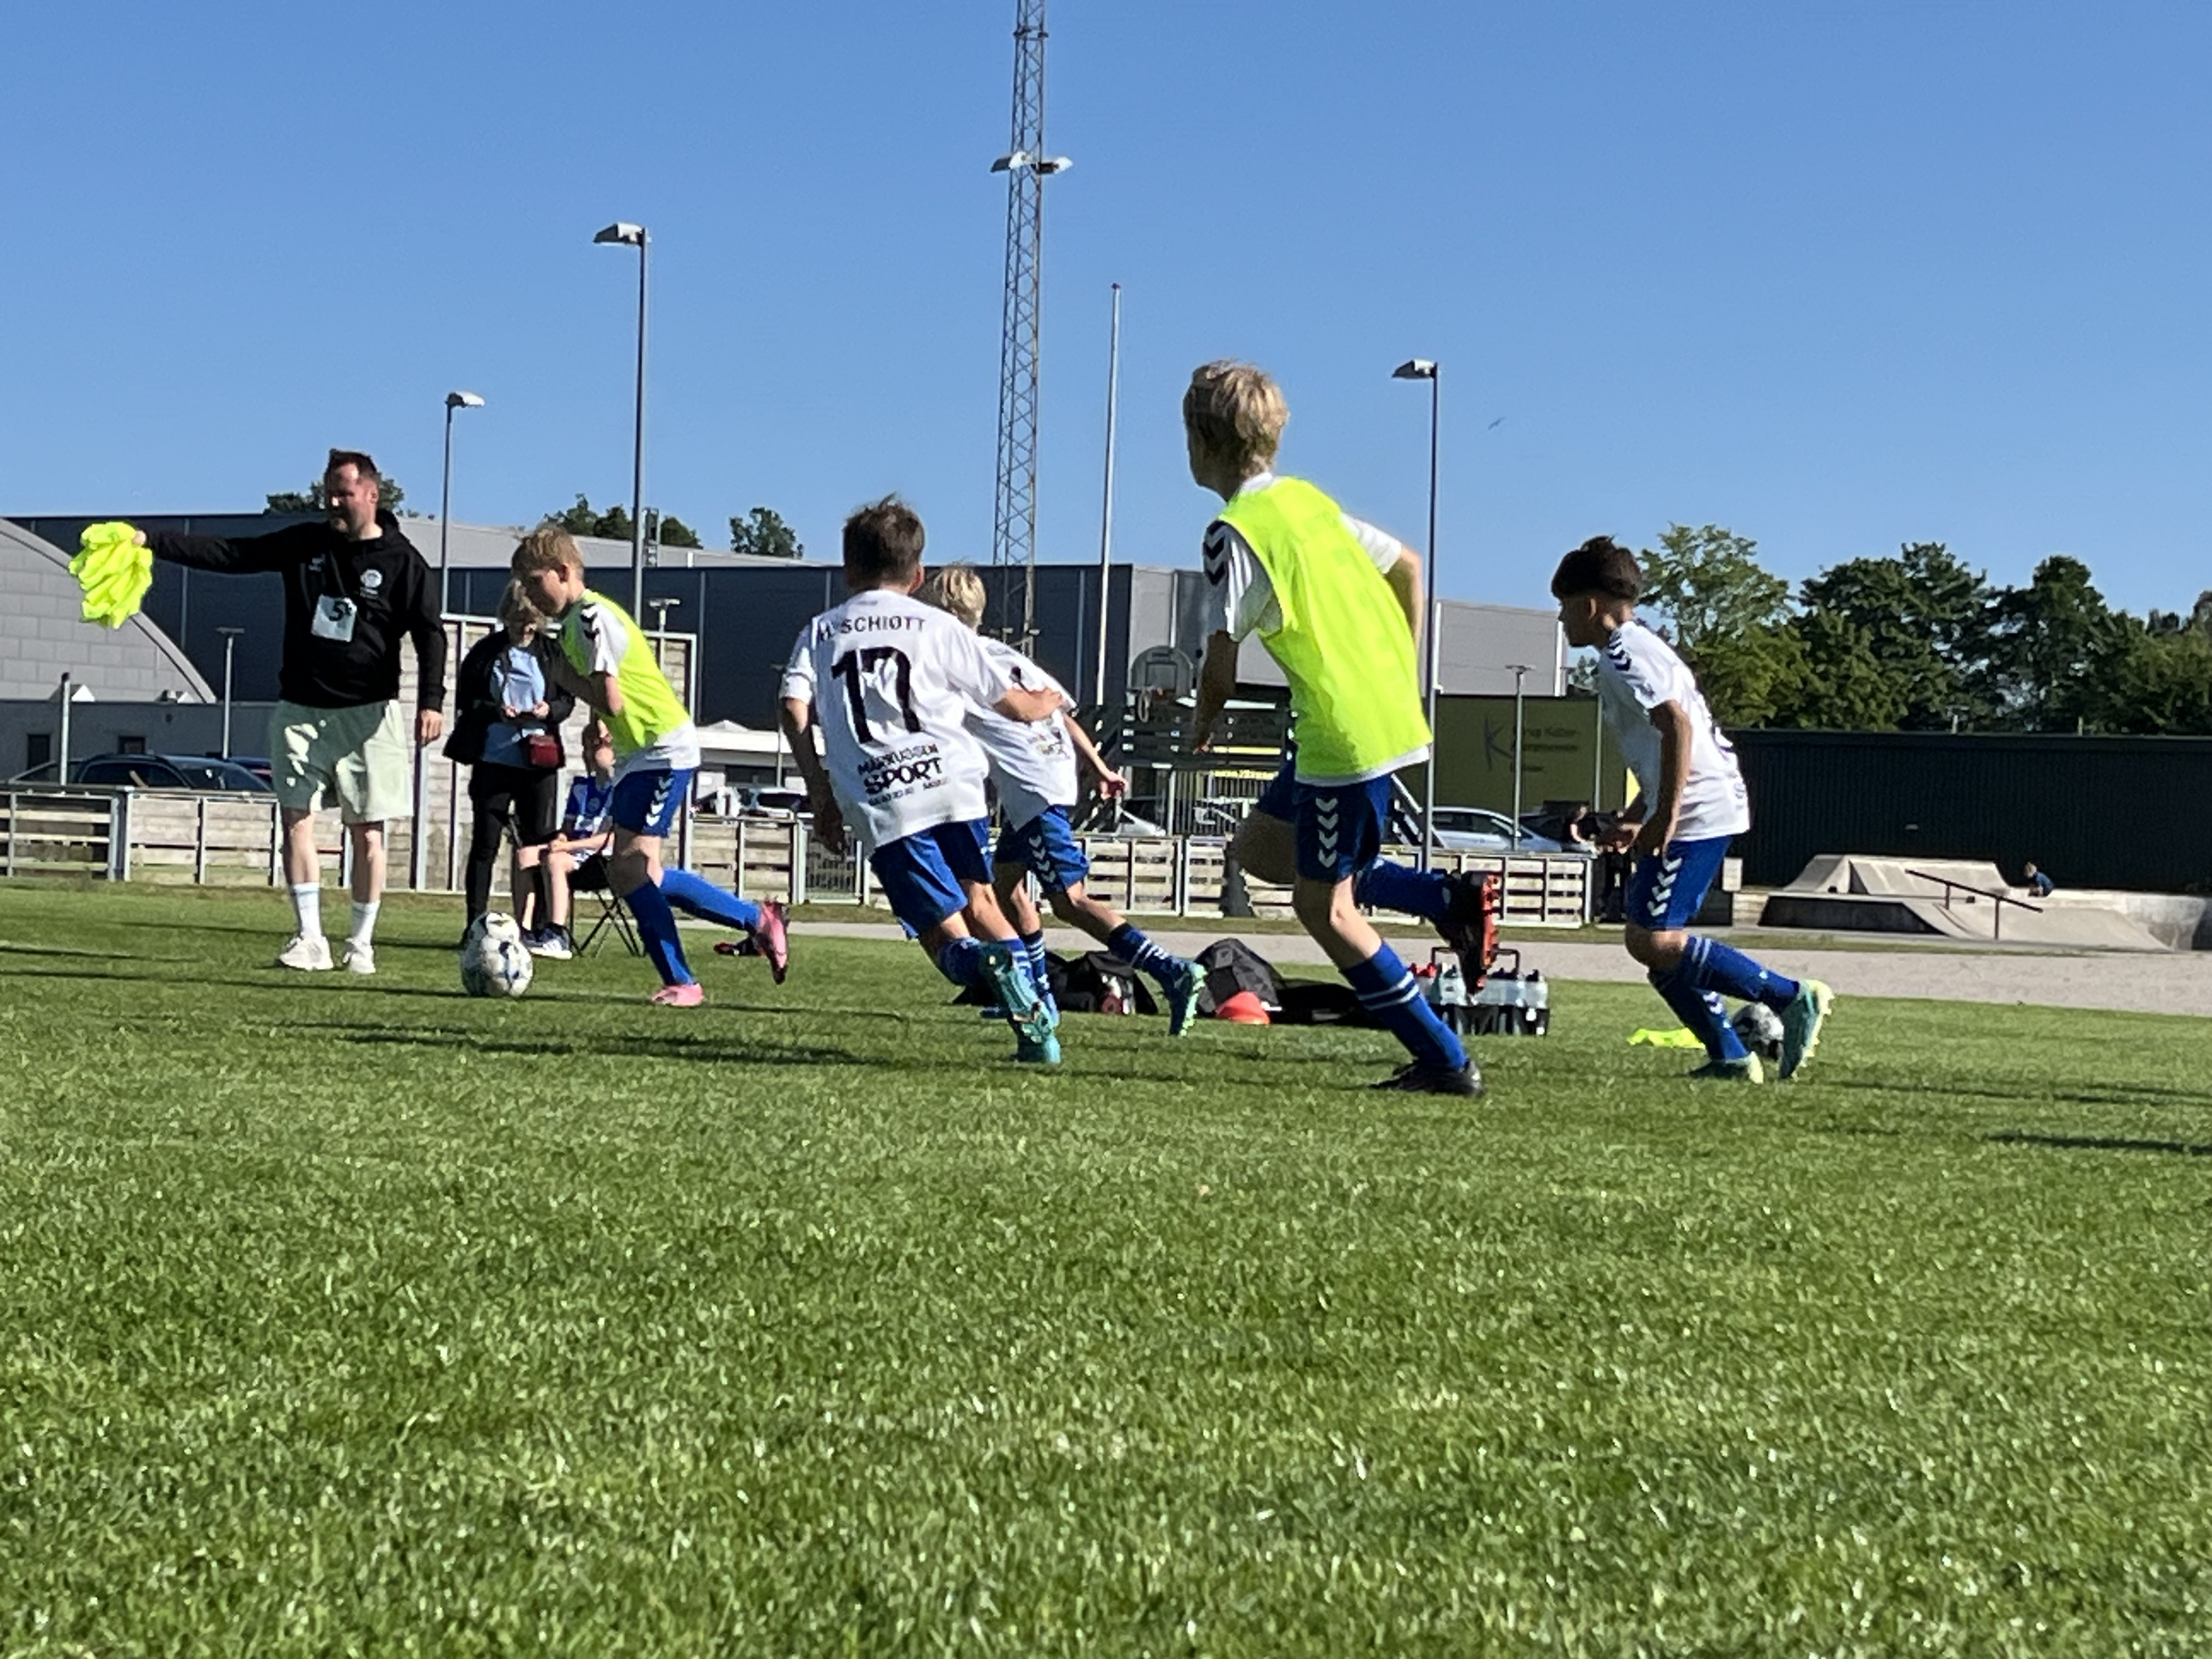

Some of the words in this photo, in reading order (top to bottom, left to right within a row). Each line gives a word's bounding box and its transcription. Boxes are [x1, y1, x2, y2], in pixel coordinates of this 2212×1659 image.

[840, 616, 926, 634] SCHIØTT
[831, 646, 922, 743] 17
[864, 757, 943, 794] SPORT
